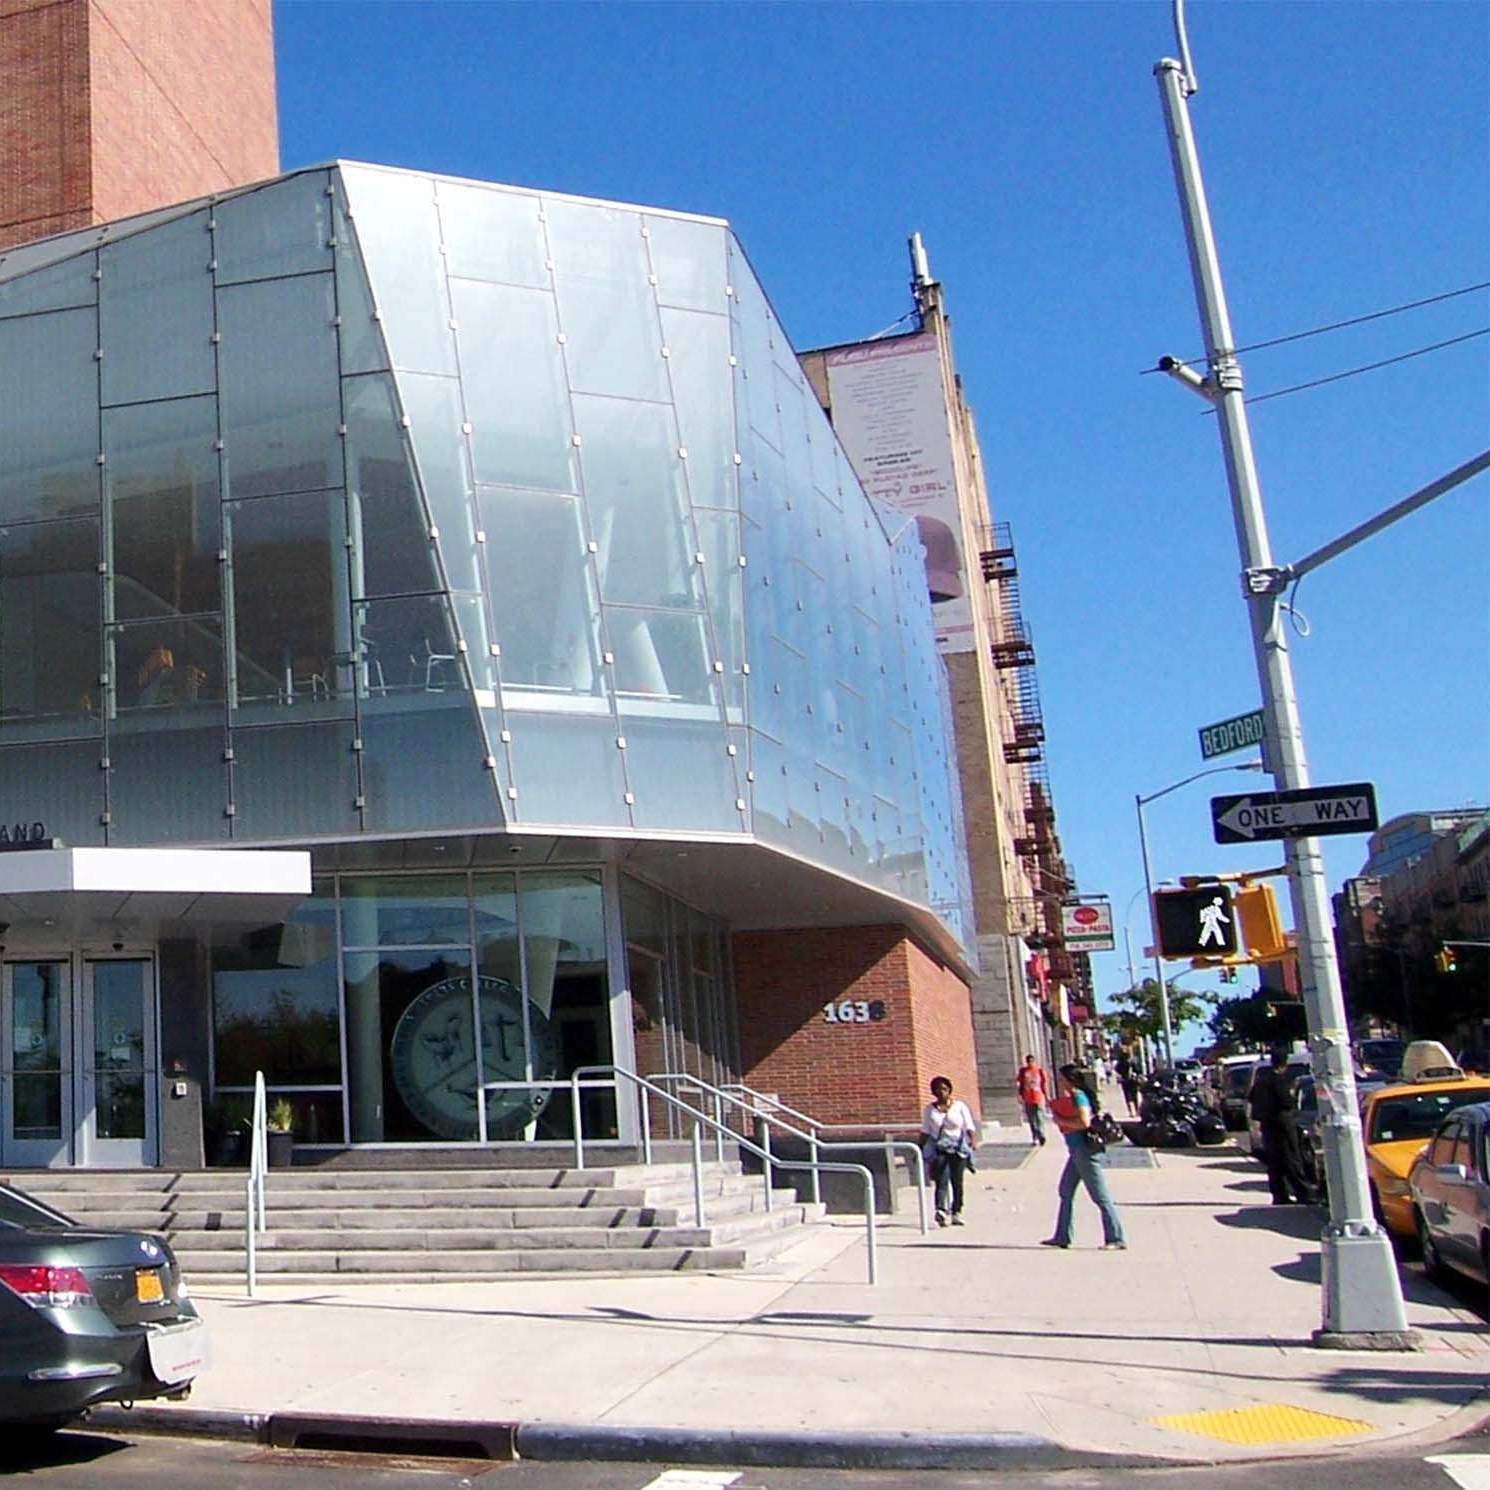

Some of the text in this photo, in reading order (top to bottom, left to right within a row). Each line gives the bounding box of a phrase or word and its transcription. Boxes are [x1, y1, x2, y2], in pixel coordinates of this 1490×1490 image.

[1202, 715, 1264, 755] BEDFORD
[1238, 800, 1361, 828] ONE WAY
